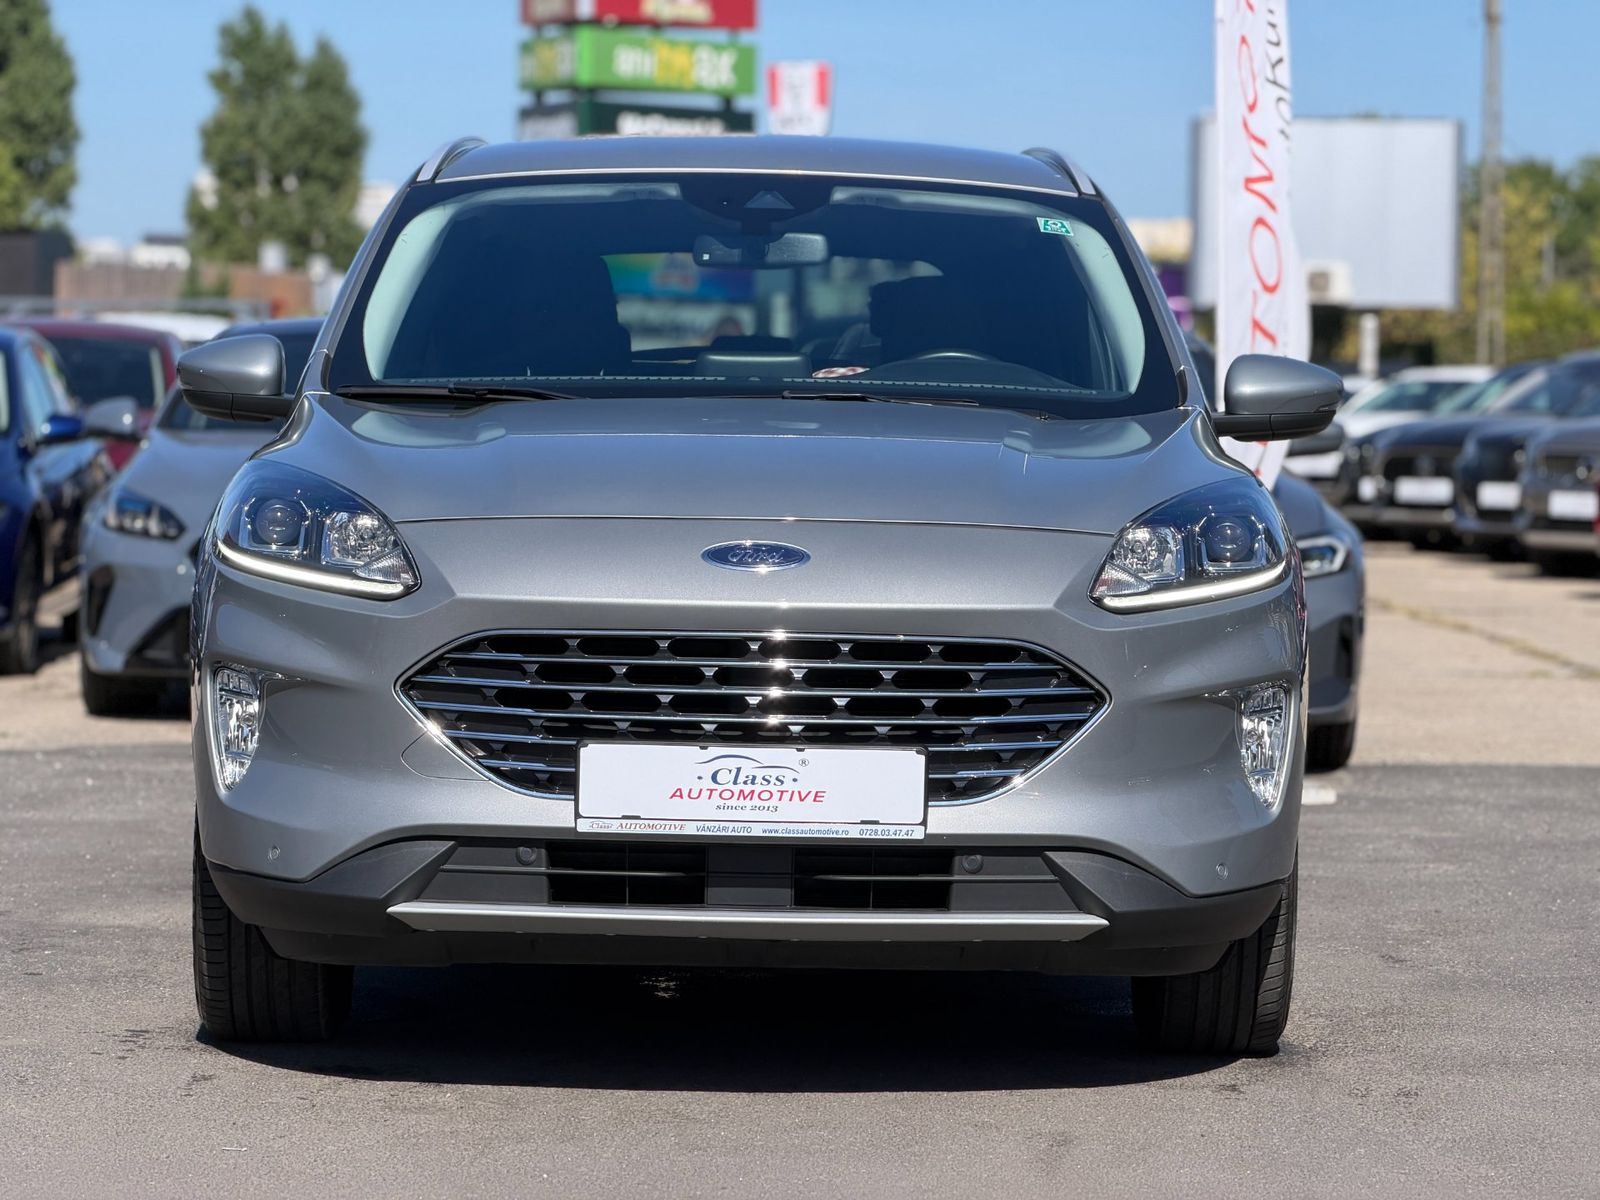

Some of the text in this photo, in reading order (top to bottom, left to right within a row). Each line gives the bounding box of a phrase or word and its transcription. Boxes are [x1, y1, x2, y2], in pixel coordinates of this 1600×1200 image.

[710, 766, 786, 787] Class
[669, 787, 827, 803] AUTOMOTIVE
[715, 803, 779, 813] since 2013
[616, 822, 687, 832] AUTOMOTIVE
[730, 825, 753, 834] AUTO
[761, 826, 850, 836] www.classautomotive.ro
[858, 828, 915, 837] 0728.03.47.47
